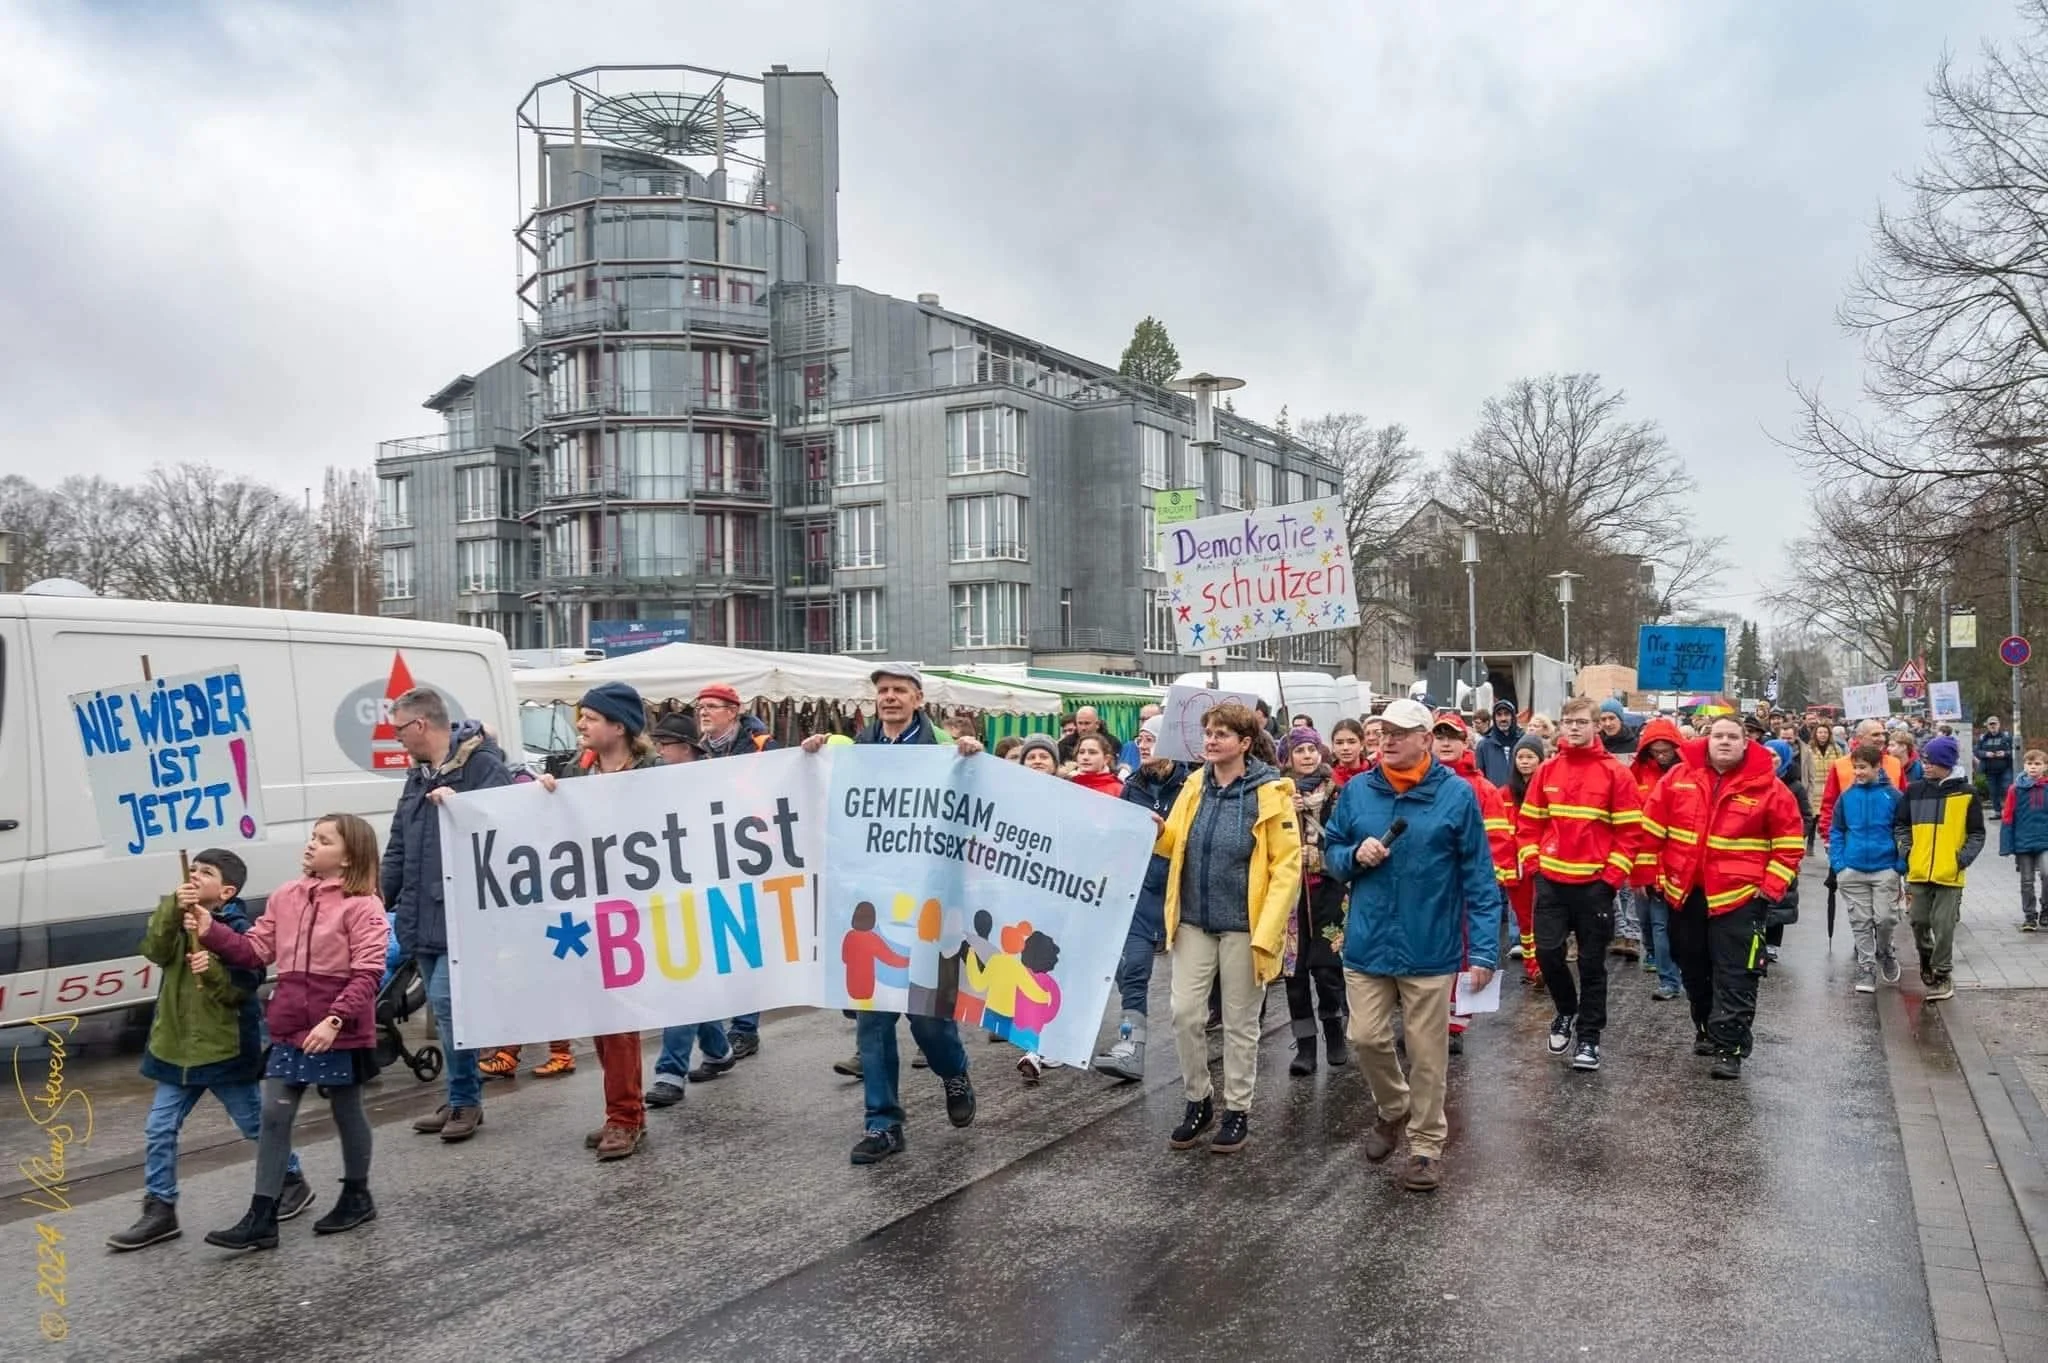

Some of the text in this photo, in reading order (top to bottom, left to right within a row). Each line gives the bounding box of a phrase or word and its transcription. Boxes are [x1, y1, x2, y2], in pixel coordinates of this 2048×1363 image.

[1172, 514, 1317, 566] Demokratie
[1202, 559, 1345, 613] schützen
[1647, 634, 1671, 652] Nie
[74, 678, 252, 757] NIE WIEDER
[472, 797, 805, 910] Kaarst ist
[844, 787, 1052, 854] GEMEINSAM gegen
[866, 821, 1108, 907] Rechtsextremismus!
